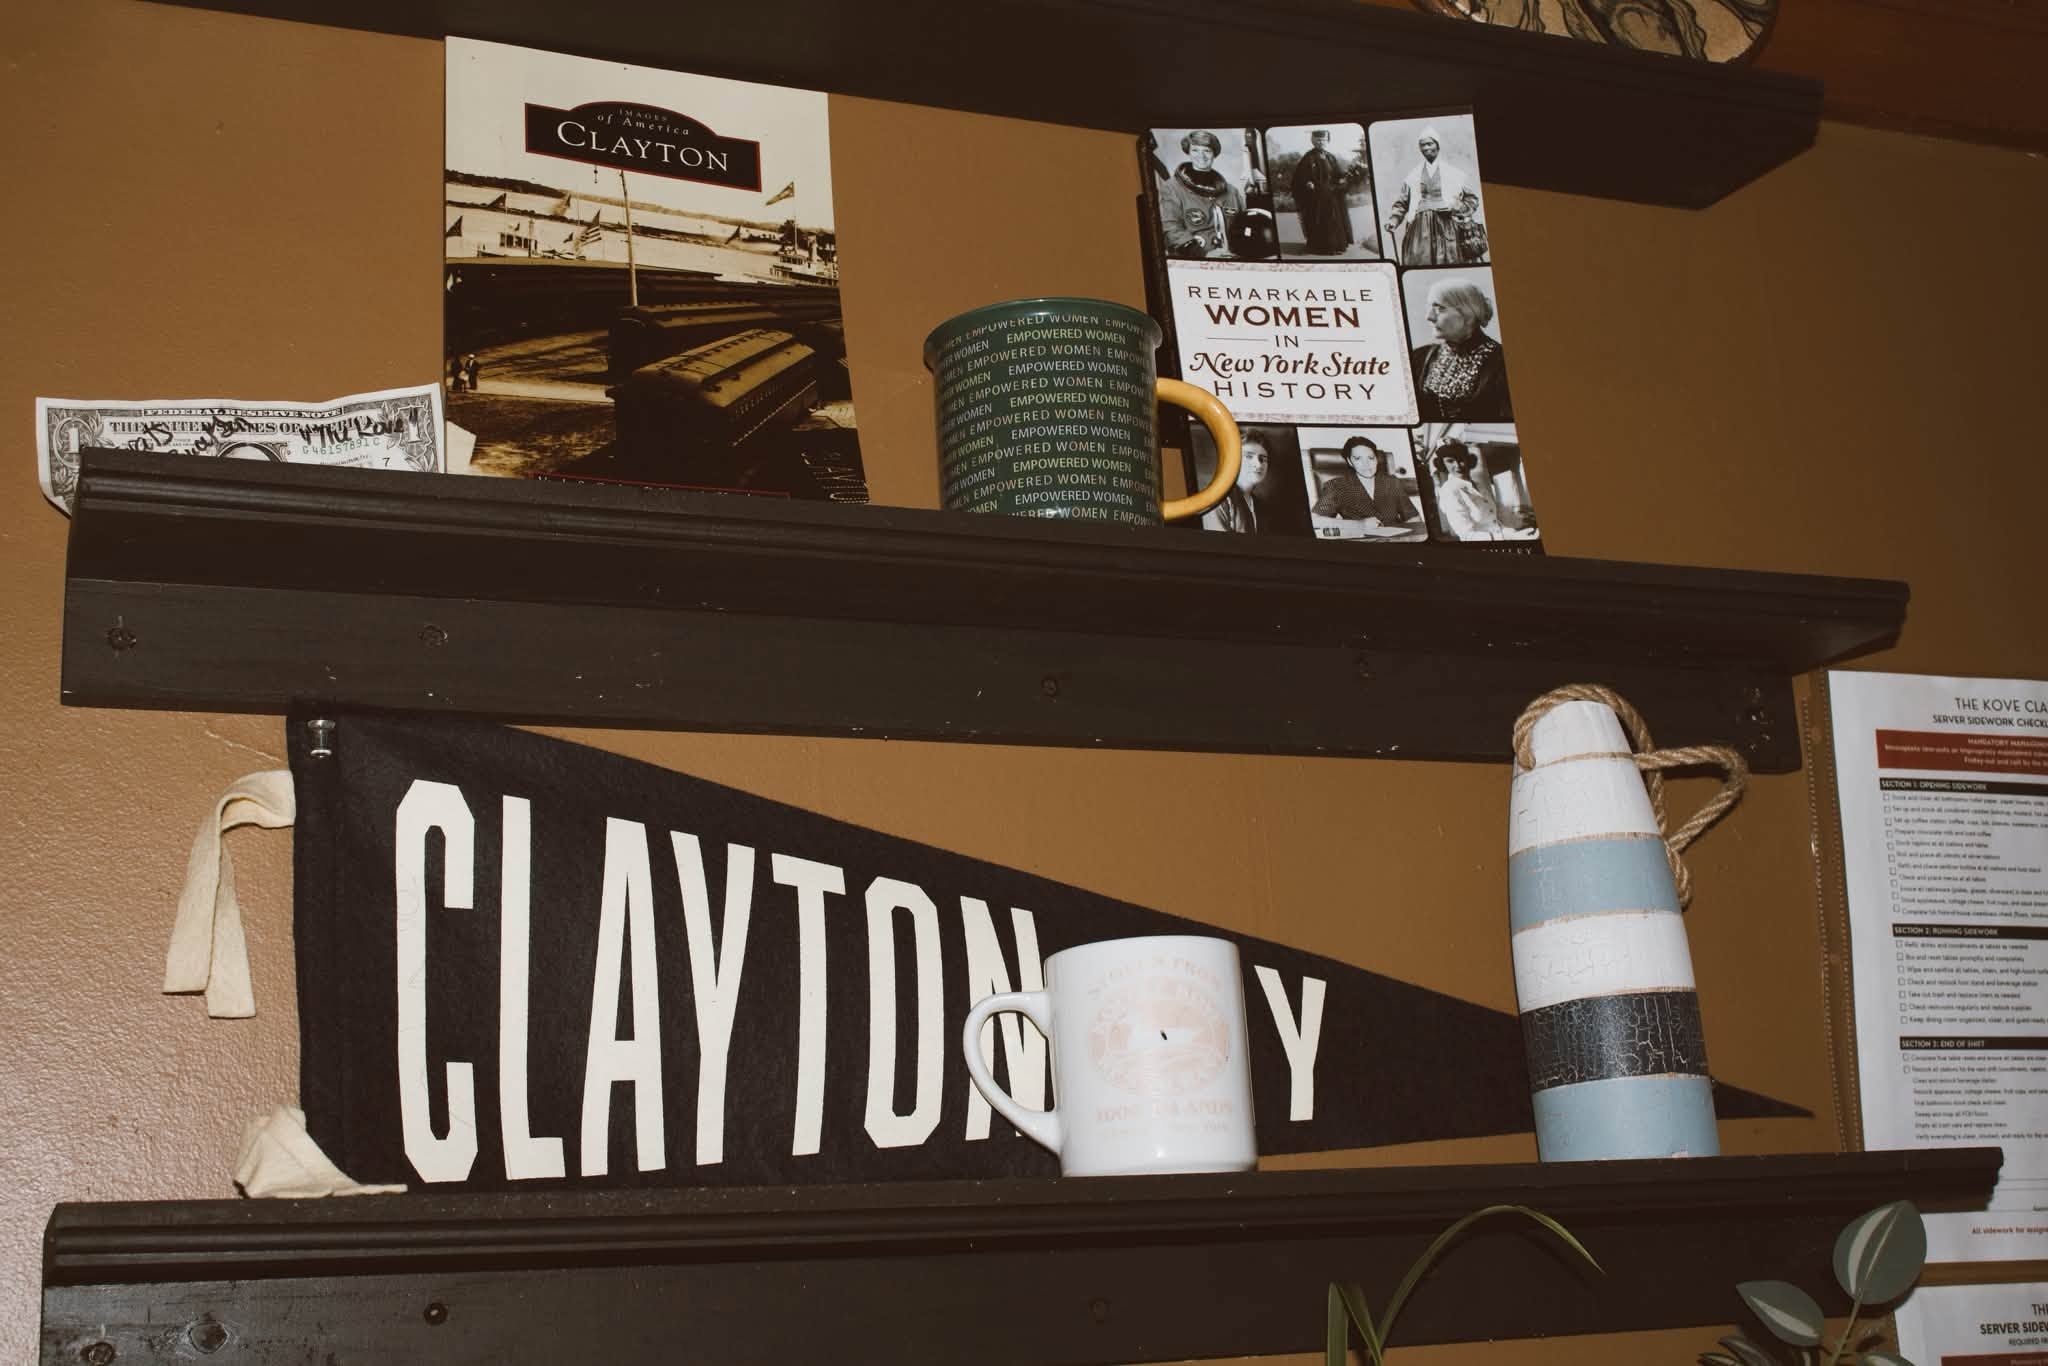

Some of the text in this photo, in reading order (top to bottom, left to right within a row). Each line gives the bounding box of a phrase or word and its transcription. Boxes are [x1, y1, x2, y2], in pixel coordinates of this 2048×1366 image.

[597, 113, 689, 135] of America
[557, 121, 728, 172] CLAYTON
[1188, 286, 1373, 301] REMARKABLE
[1050, 315, 1099, 325] WOMEN
[1204, 303, 1360, 328] WOMEN
[1007, 328, 1126, 344] EMPOWERED WOMEN
[1275, 335, 1299, 348] IN
[954, 339, 990, 361] WOMEN
[967, 345, 1046, 371] EMPOWERED
[1051, 344, 1101, 356] WOMEN
[1008, 360, 1128, 377] EMPOWERED WOMEN
[1189, 352, 1390, 378] New York State
[955, 371, 991, 392] WOMEN
[969, 377, 1048, 402] EMPOWERED
[1053, 376, 1103, 388] WOMEN
[1213, 380, 1376, 400] HISTORY
[1010, 393, 1130, 408] EMPOWERED WOMEN
[956, 403, 992, 425] WOMEN
[970, 409, 1049, 435] EMPOWERED
[1055, 408, 1104, 420] WOMEN
[1011, 425, 1131, 441] EMPOWERED WOMEN
[958, 434, 994, 456] WOMEN
[382, 456, 390, 467] 7
[971, 442, 1051, 467] EMPOWERED
[1056, 441, 1105, 453] WOMEN
[1013, 457, 1132, 473] EMPOWERED WOMEN
[960, 467, 995, 489] WOMEN
[974, 474, 1053, 500] EMPOWERED
[1057, 473, 1106, 485] WOMEN
[1015, 490, 1133, 506] EMPOWERED WOMEN
[967, 499, 998, 514] OMEN
[1058, 506, 1108, 519] WOMEN
[1955, 697, 1979, 711] THE
[1983, 698, 2021, 712] KOVE
[1932, 714, 1965, 725] SERVER
[1967, 716, 2015, 727] SIDEWORK
[1881, 779, 1912, 788] SECTION
[1952, 782, 1987, 791] SIDEWORK
[1894, 926, 1924, 935] SECTION
[1964, 927, 1999, 936] SIDEWORK
[394, 778, 1327, 1184] CLAYTON Y
[1901, 1039, 1931, 1048] SECTION
[1940, 1040, 1955, 1048] END
[1979, 1322, 2021, 1335] SERVER
